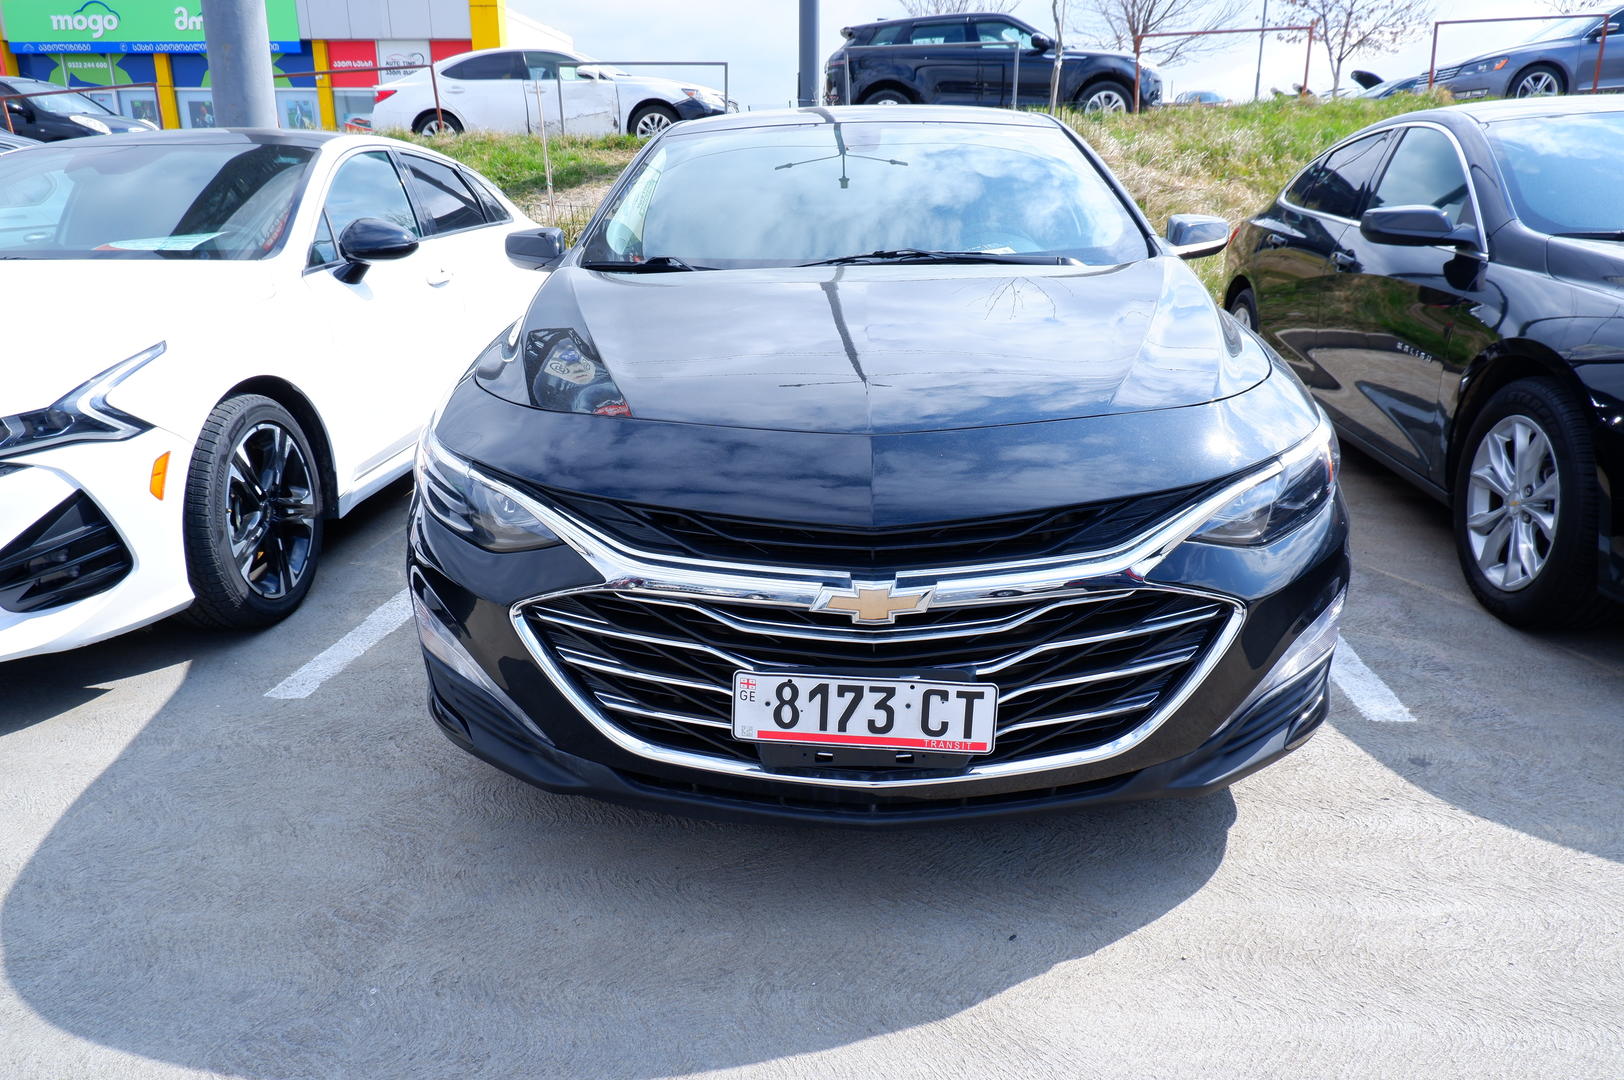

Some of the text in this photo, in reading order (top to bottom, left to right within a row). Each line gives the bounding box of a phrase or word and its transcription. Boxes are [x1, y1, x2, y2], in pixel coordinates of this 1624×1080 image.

[50, 14, 119, 39] mogo
[739, 689, 756, 702] GE
[773, 680, 985, 740] 8173 CT
[923, 739, 973, 750] TRANSIT
